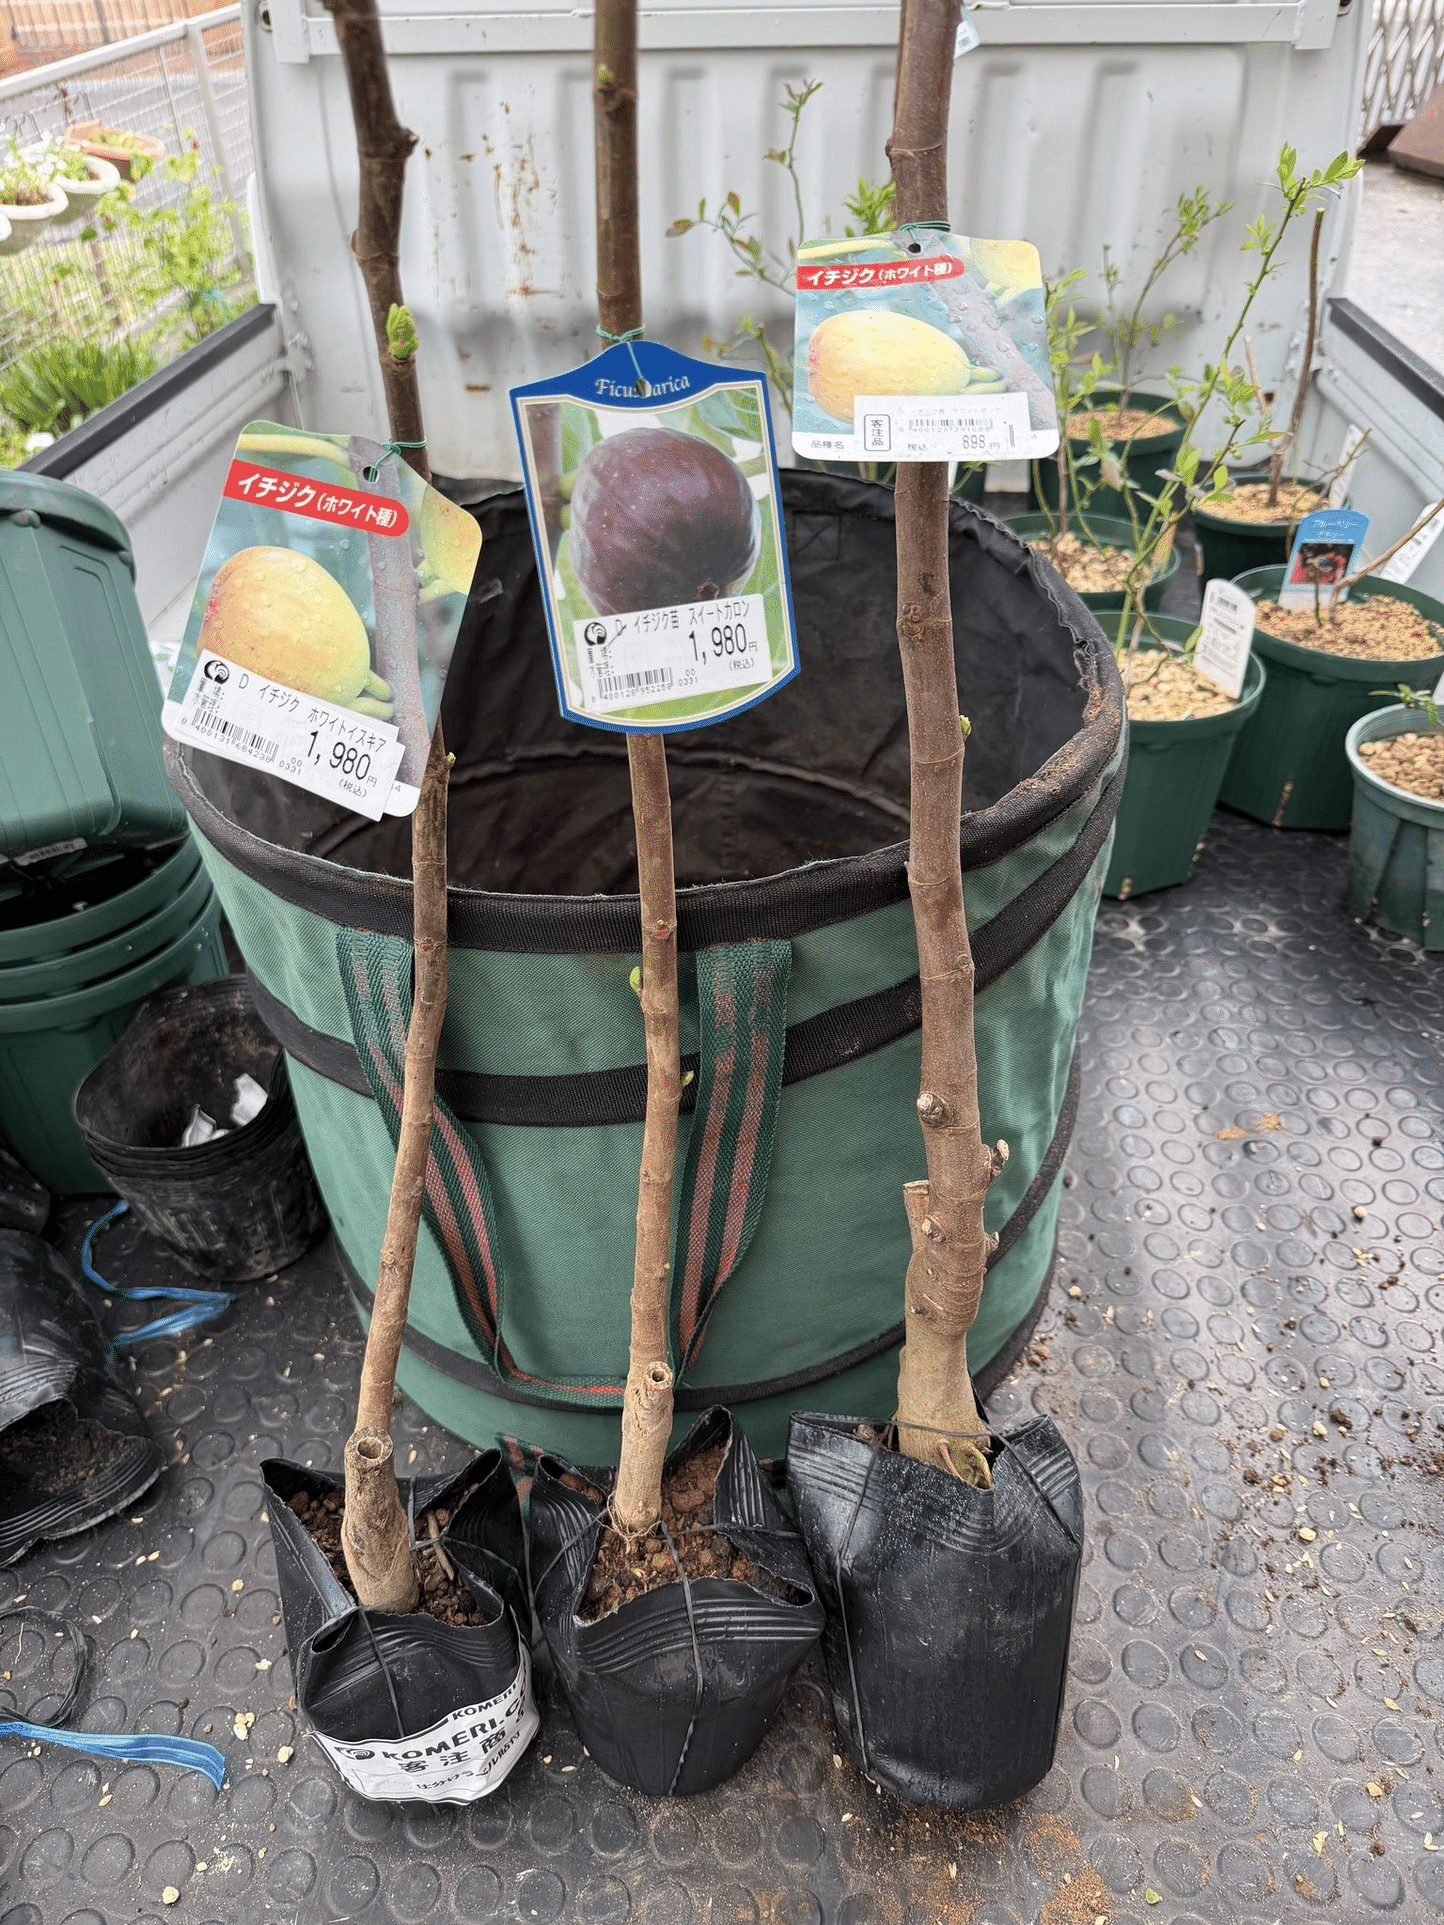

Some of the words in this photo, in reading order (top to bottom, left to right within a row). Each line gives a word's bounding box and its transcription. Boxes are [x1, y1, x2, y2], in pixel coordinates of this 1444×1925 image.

[652, 376, 691, 396] arica
[811, 439, 845, 450] 品種名
[634, 609, 680, 634] イチジク苗
[688, 601, 750, 626] スイートカロン
[239, 673, 250, 689] D
[259, 684, 300, 713] イチジク
[307, 707, 387, 753] ホワイトイスキア
